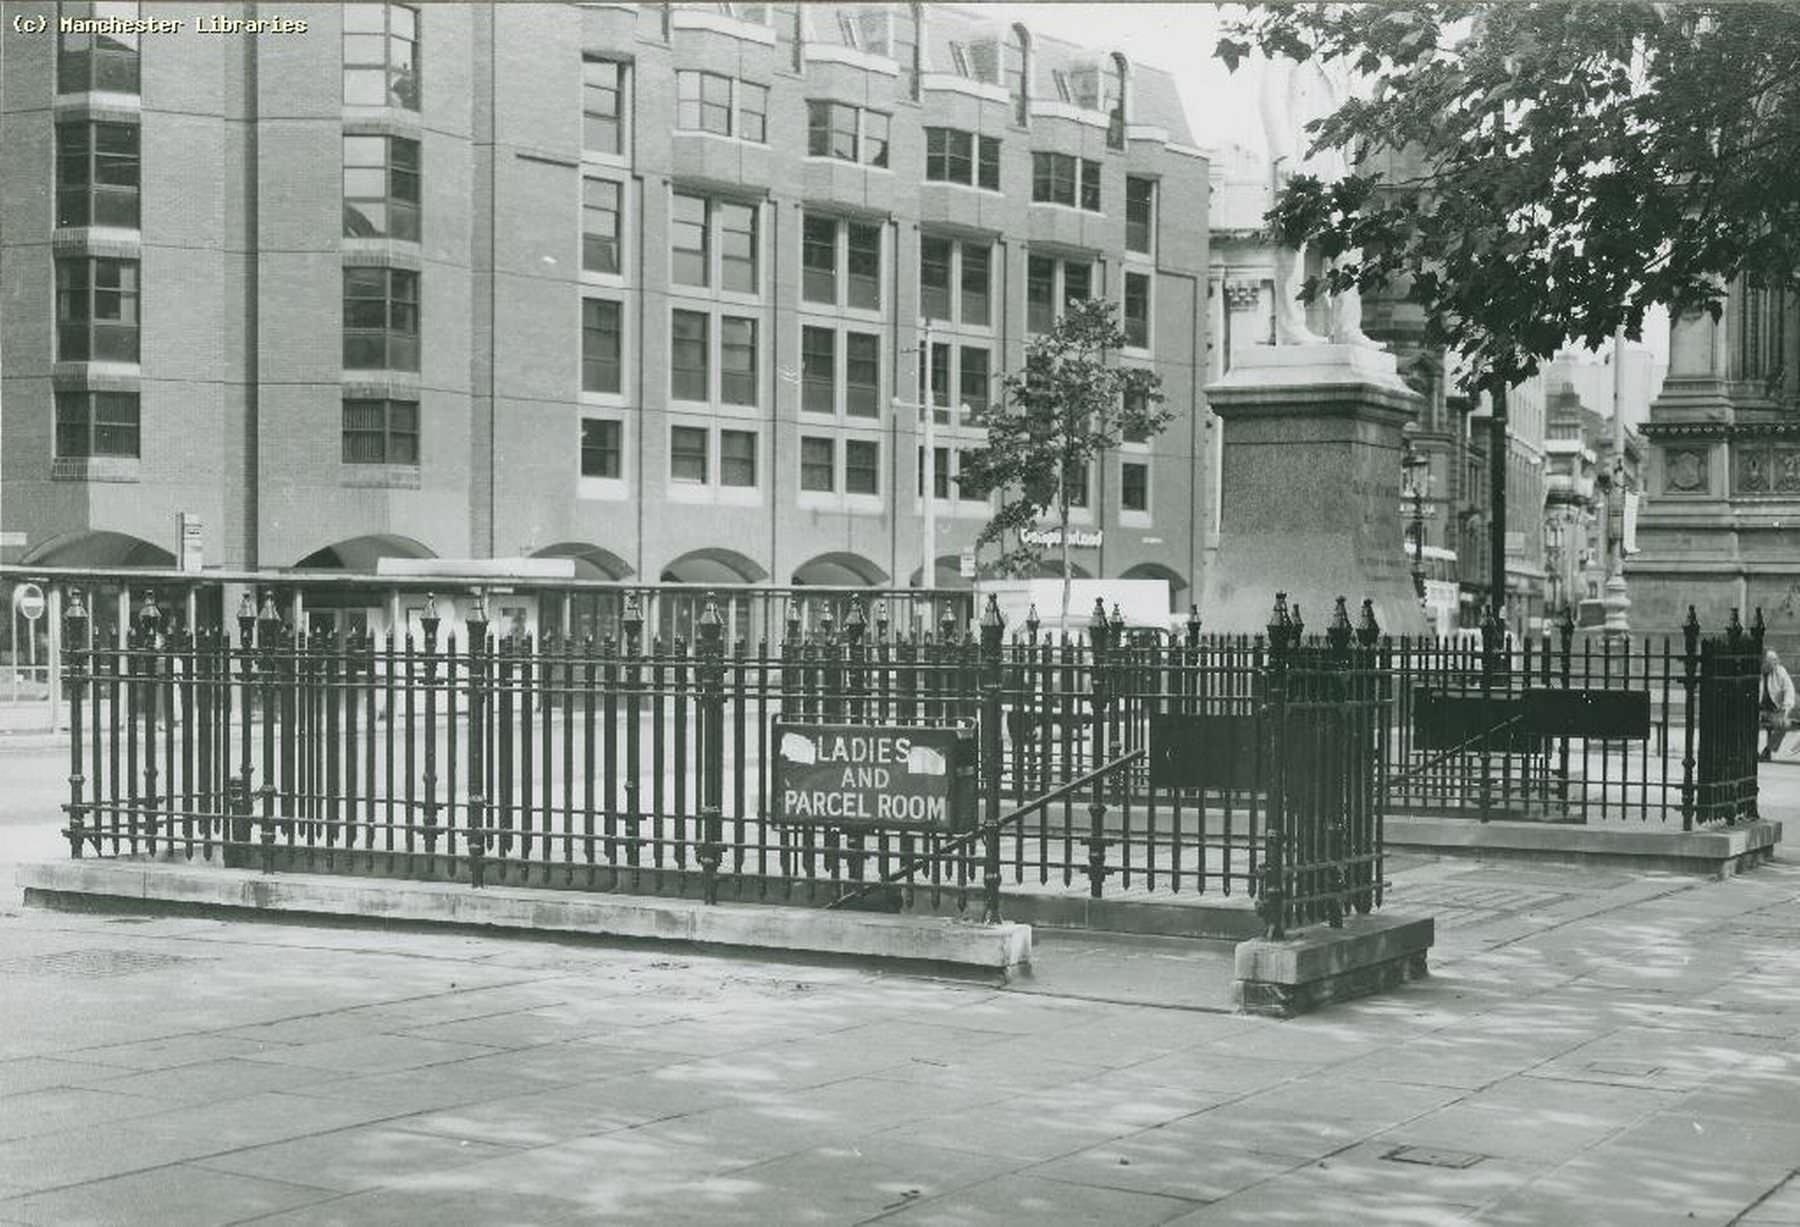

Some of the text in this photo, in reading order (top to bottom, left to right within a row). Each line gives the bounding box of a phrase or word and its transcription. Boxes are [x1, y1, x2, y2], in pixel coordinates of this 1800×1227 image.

[817, 736, 911, 764] LADIES
[841, 768, 890, 789] AND
[784, 790, 947, 821] PARCEL ROOM
